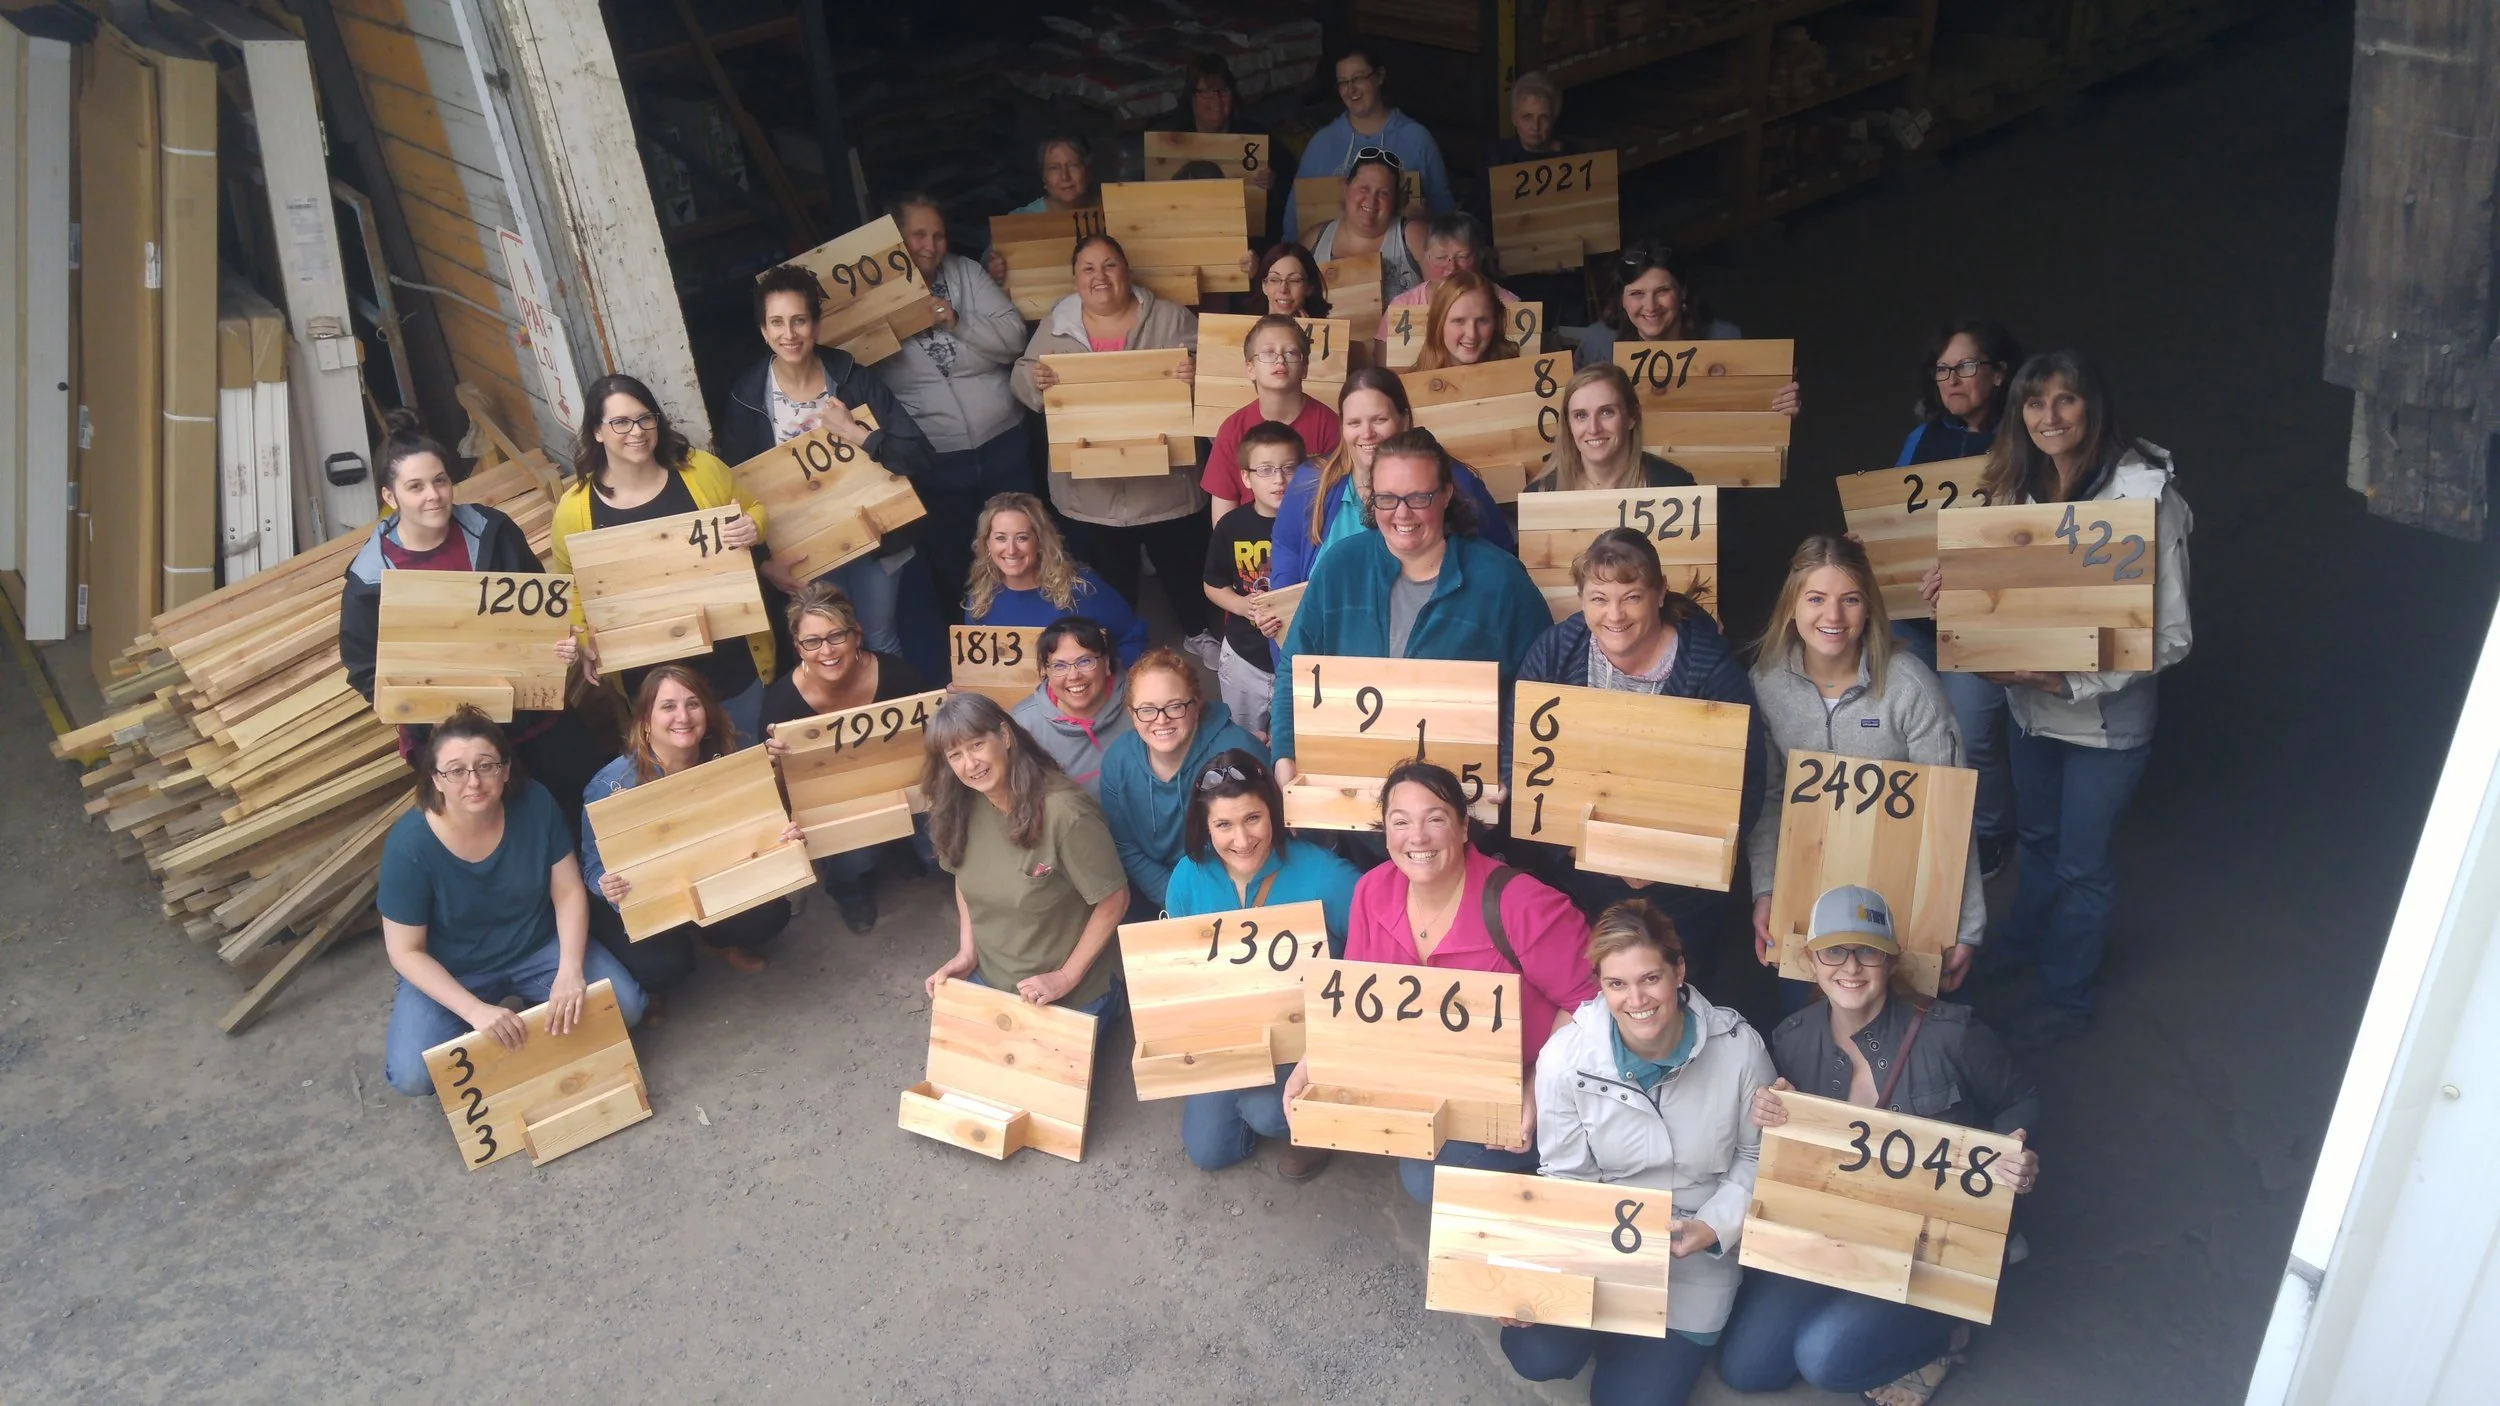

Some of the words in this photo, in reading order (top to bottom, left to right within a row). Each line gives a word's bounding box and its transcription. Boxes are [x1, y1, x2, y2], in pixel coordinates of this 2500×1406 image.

[1243, 142, 1260, 171] 8
[819, 250, 913, 299] 909
[1631, 347, 1698, 389] 707
[1535, 359, 1560, 463] 80
[792, 420, 873, 481] 108
[1618, 496, 1702, 541] 1521
[2055, 506, 2146, 583] 422
[478, 577, 570, 617] 1208
[953, 630, 1023, 667] 1813
[1791, 758, 1919, 820] 2498
[1320, 969, 1503, 1033] 46261
[1839, 1120, 2002, 1198] 3048
[1611, 1199, 1645, 1254] 8
